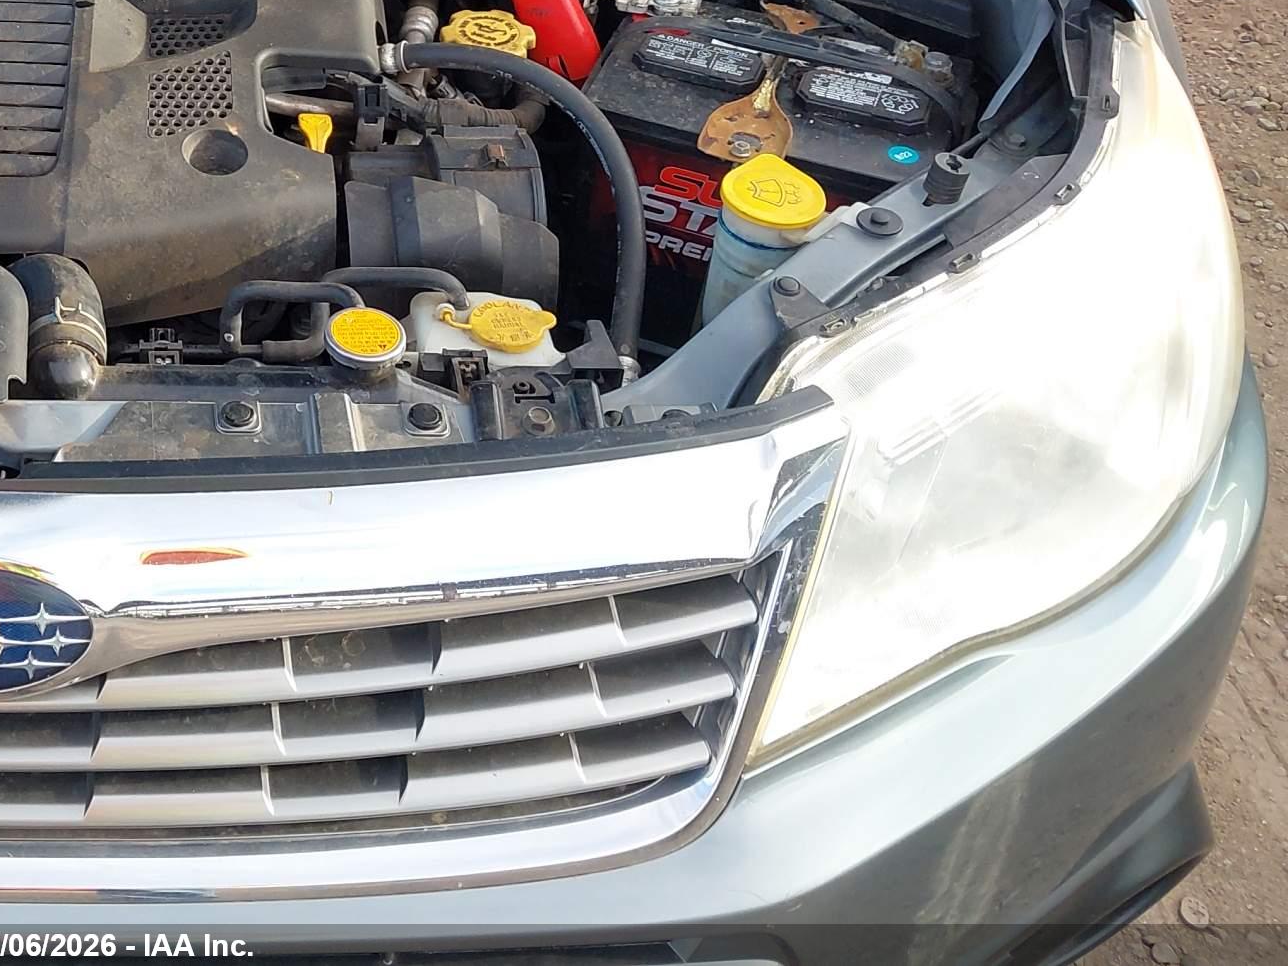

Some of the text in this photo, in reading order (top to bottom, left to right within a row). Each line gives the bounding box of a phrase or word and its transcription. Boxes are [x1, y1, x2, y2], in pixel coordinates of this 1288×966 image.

[667, 35, 704, 48] DANGER
[713, 46, 748, 59] POISON
[639, 185, 721, 235] ST
[645, 230, 712, 261] PRE
